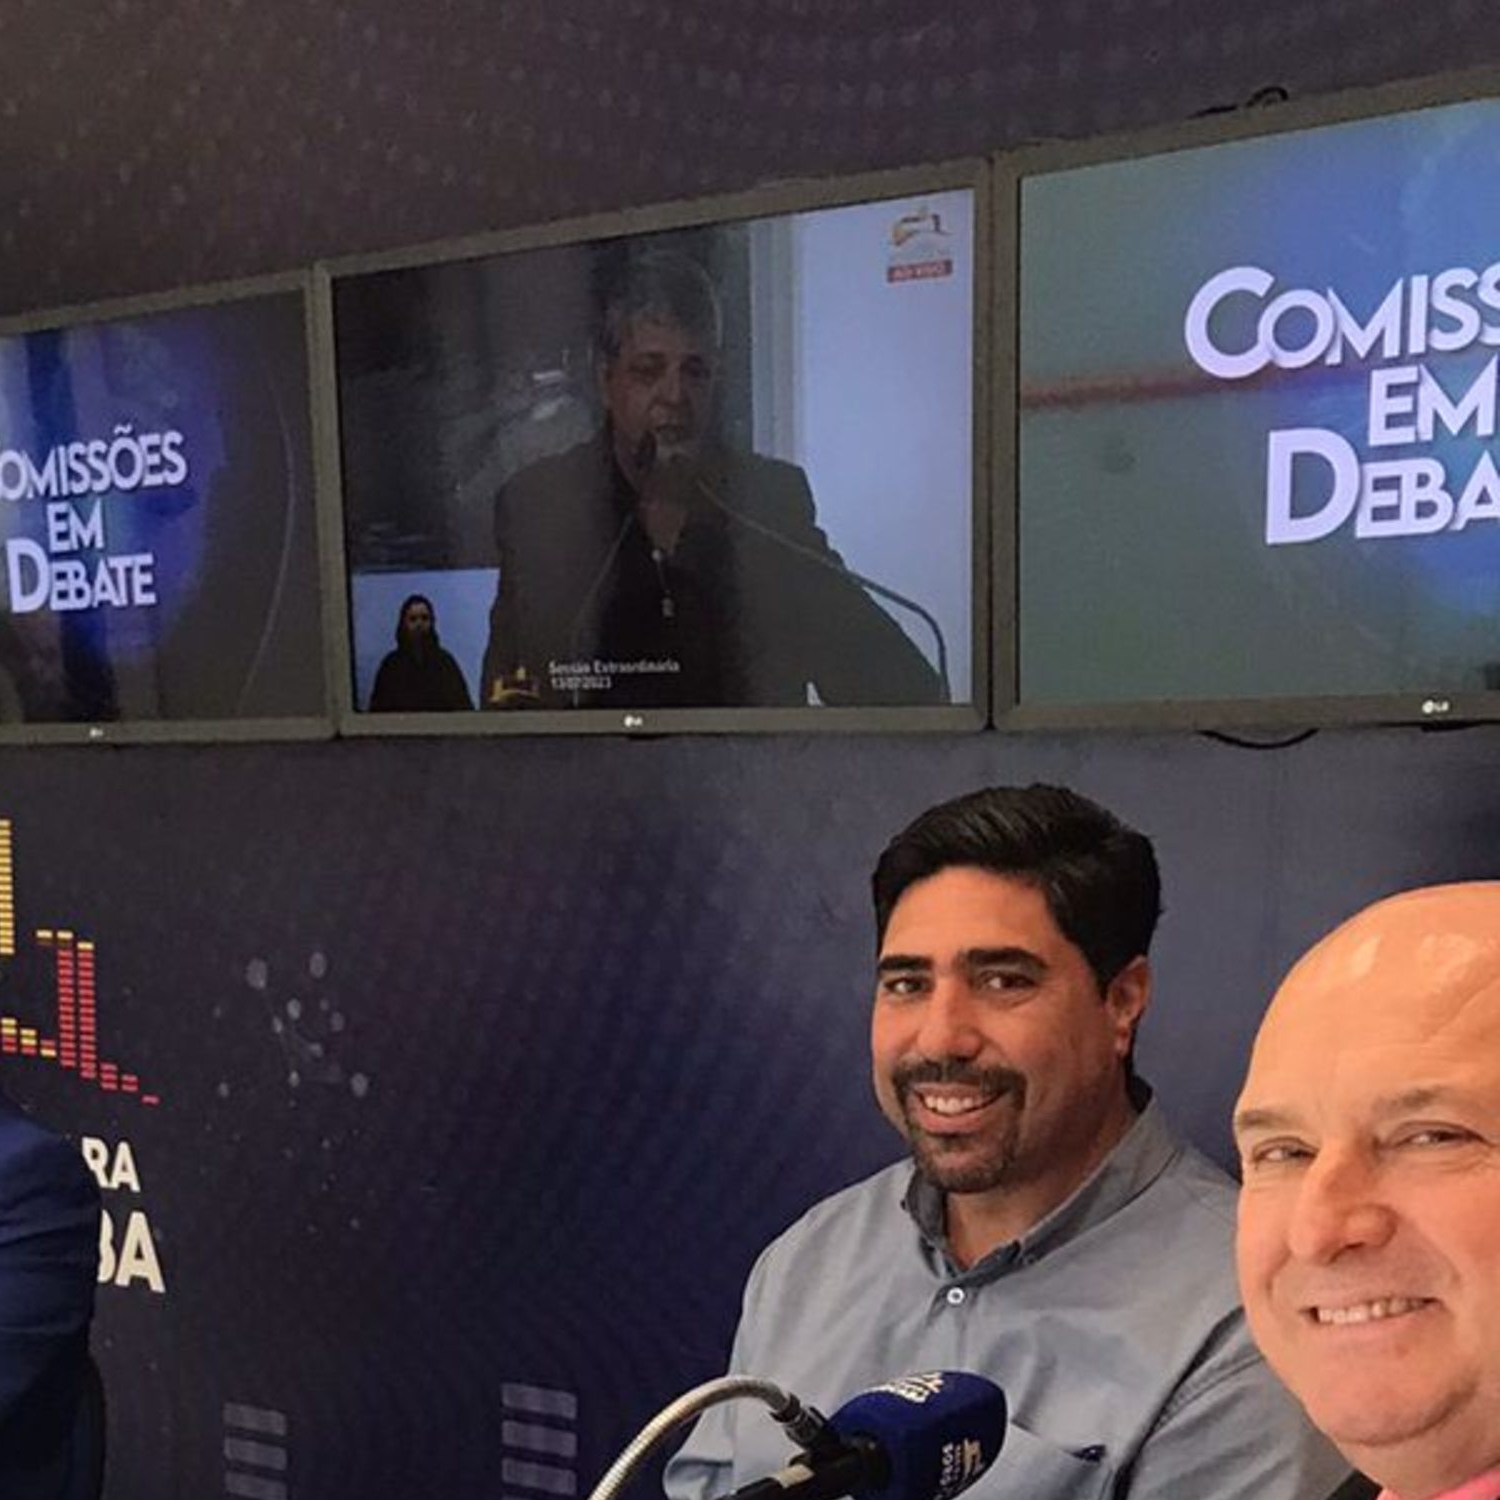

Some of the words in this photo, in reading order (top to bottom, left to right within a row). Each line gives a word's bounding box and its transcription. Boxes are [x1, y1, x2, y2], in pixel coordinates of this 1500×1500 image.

[1368, 355, 1500, 447] EM
[1266, 428, 1500, 546] DEBA
[46, 499, 104, 553] EM
[6, 538, 157, 613] DEBATE
[82, 1136, 141, 1192] RA
